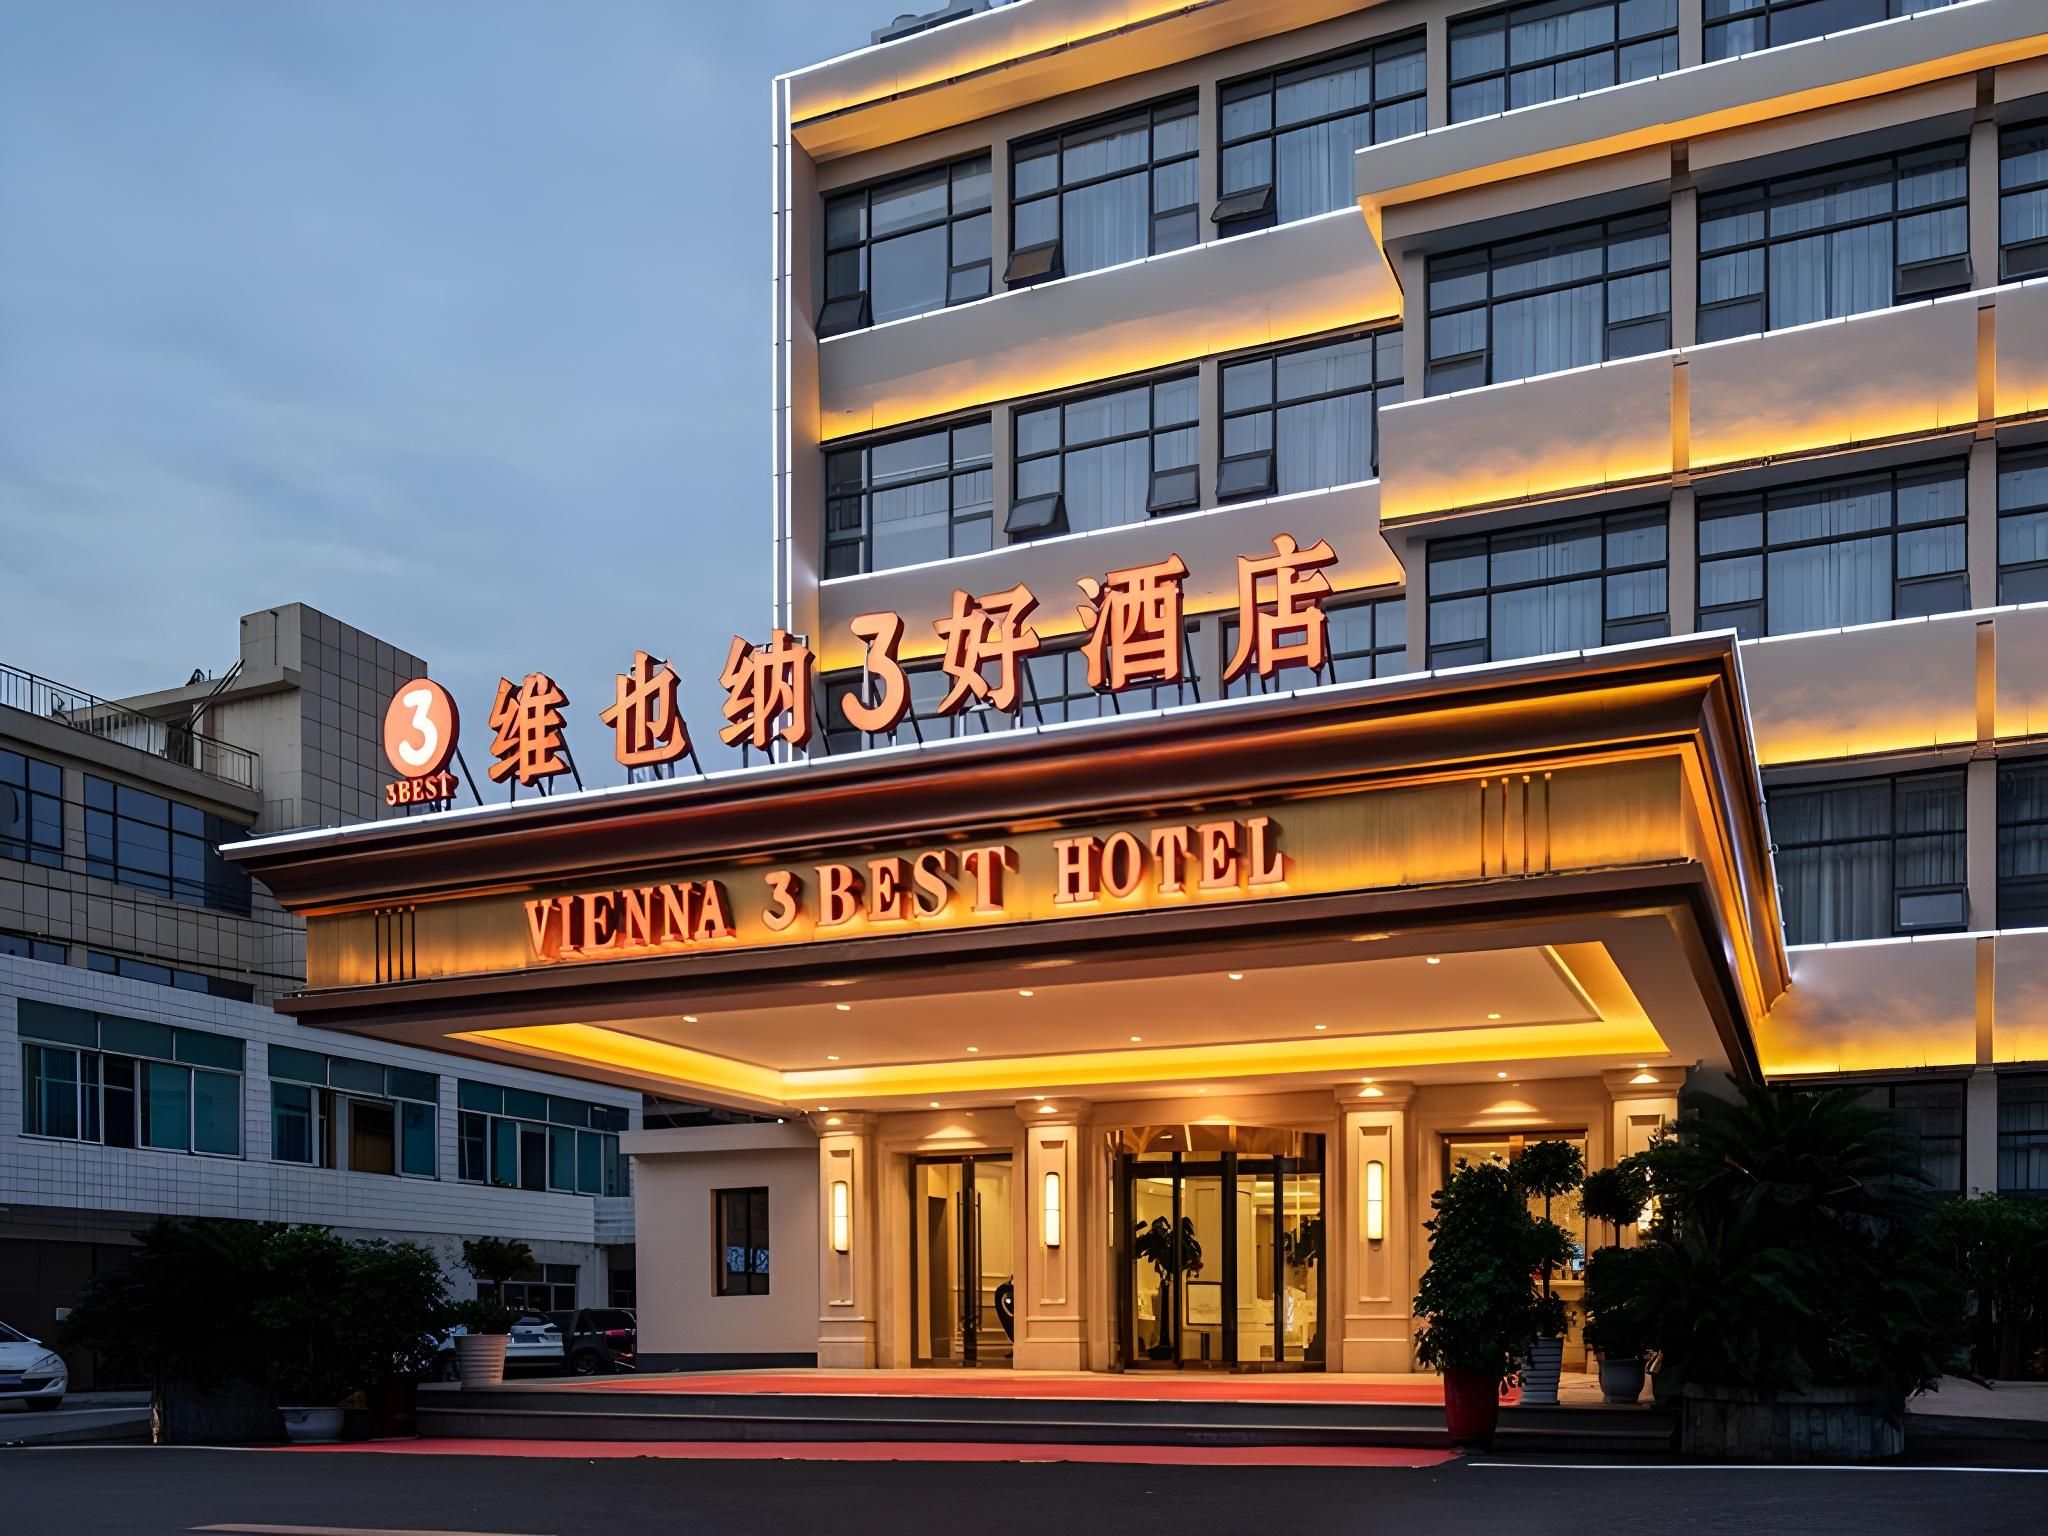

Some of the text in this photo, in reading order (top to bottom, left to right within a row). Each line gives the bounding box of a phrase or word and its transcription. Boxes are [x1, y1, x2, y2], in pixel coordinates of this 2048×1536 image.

[487, 532, 1338, 787] 维也纳3好酒店
[398, 688, 439, 767] 3
[385, 769, 456, 806] 3BEST
[524, 816, 1290, 959] VIENNA 3 BEST HOTEL
